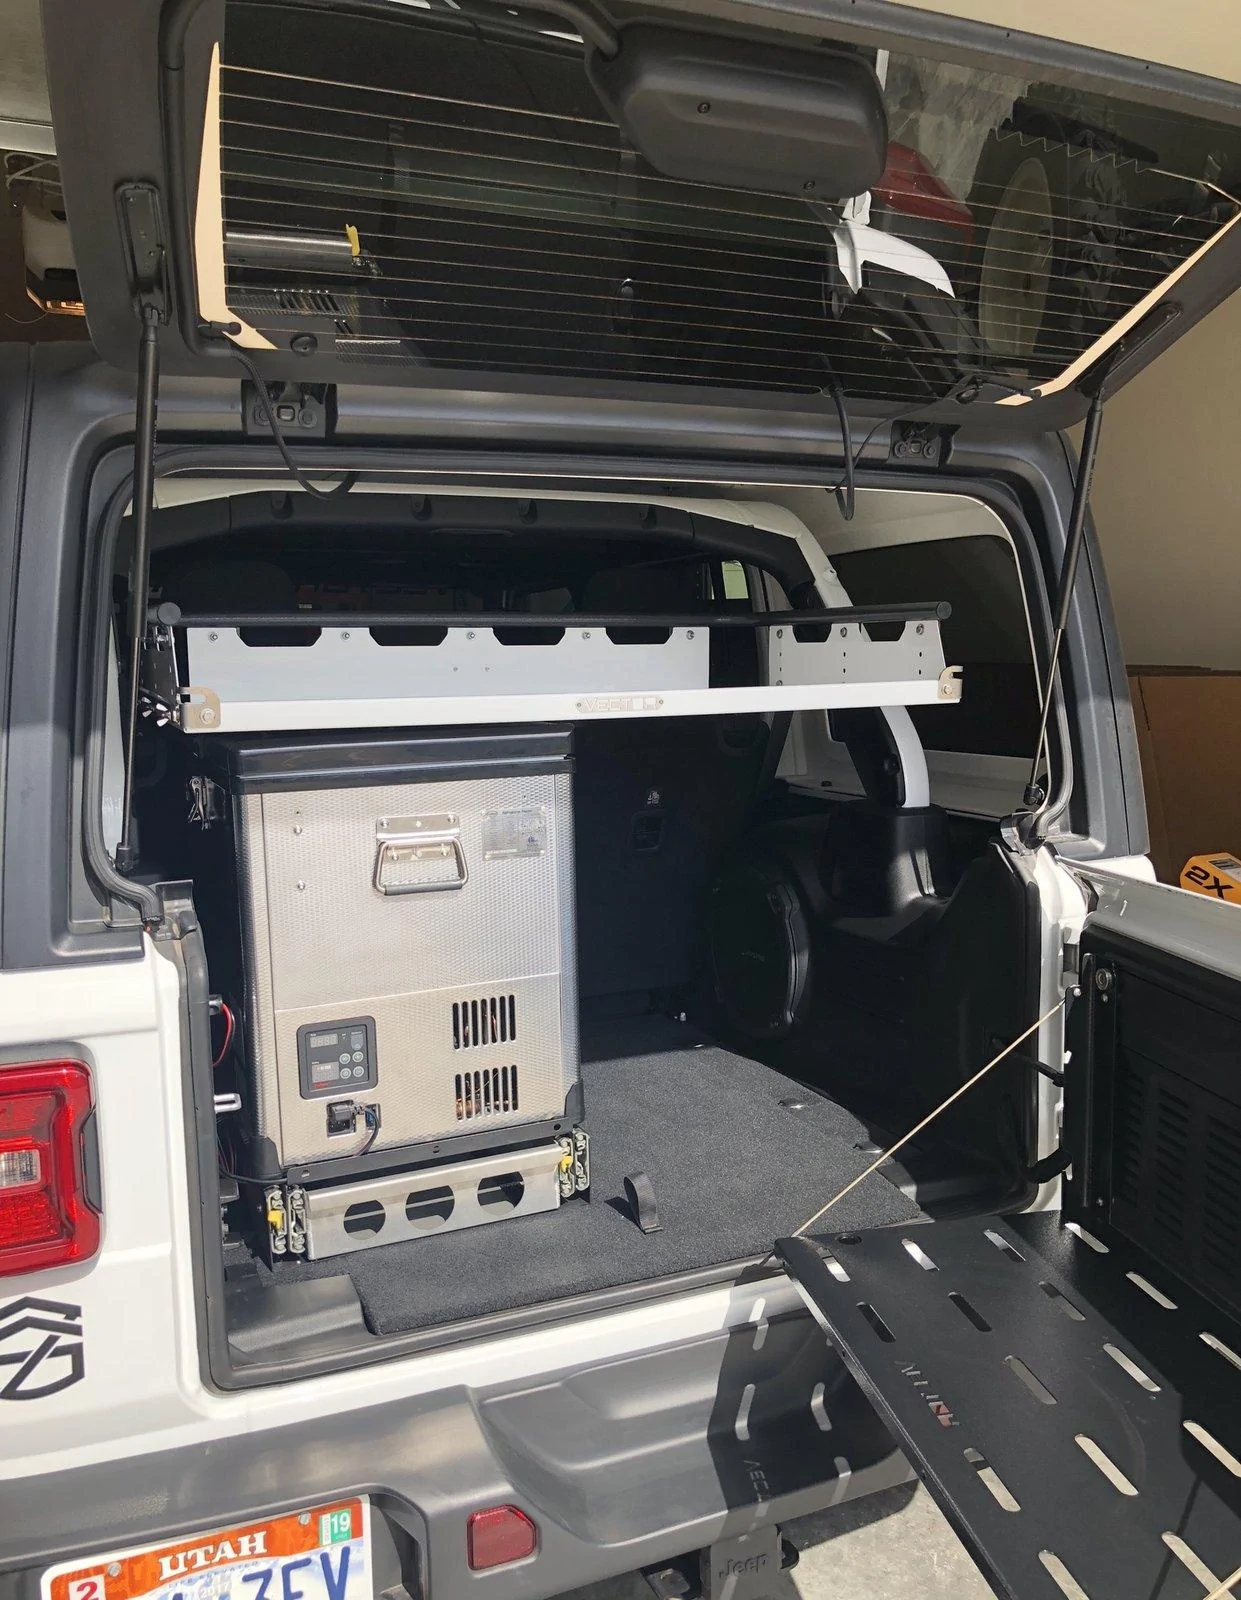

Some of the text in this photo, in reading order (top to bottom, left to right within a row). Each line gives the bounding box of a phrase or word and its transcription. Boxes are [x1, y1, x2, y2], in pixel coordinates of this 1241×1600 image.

[1184, 865, 1234, 900] 2X
[331, 1511, 350, 1534] 19
[159, 1531, 267, 1580] UTAH
[719, 1553, 769, 1579] Jeep
[76, 1581, 98, 1600] 2
